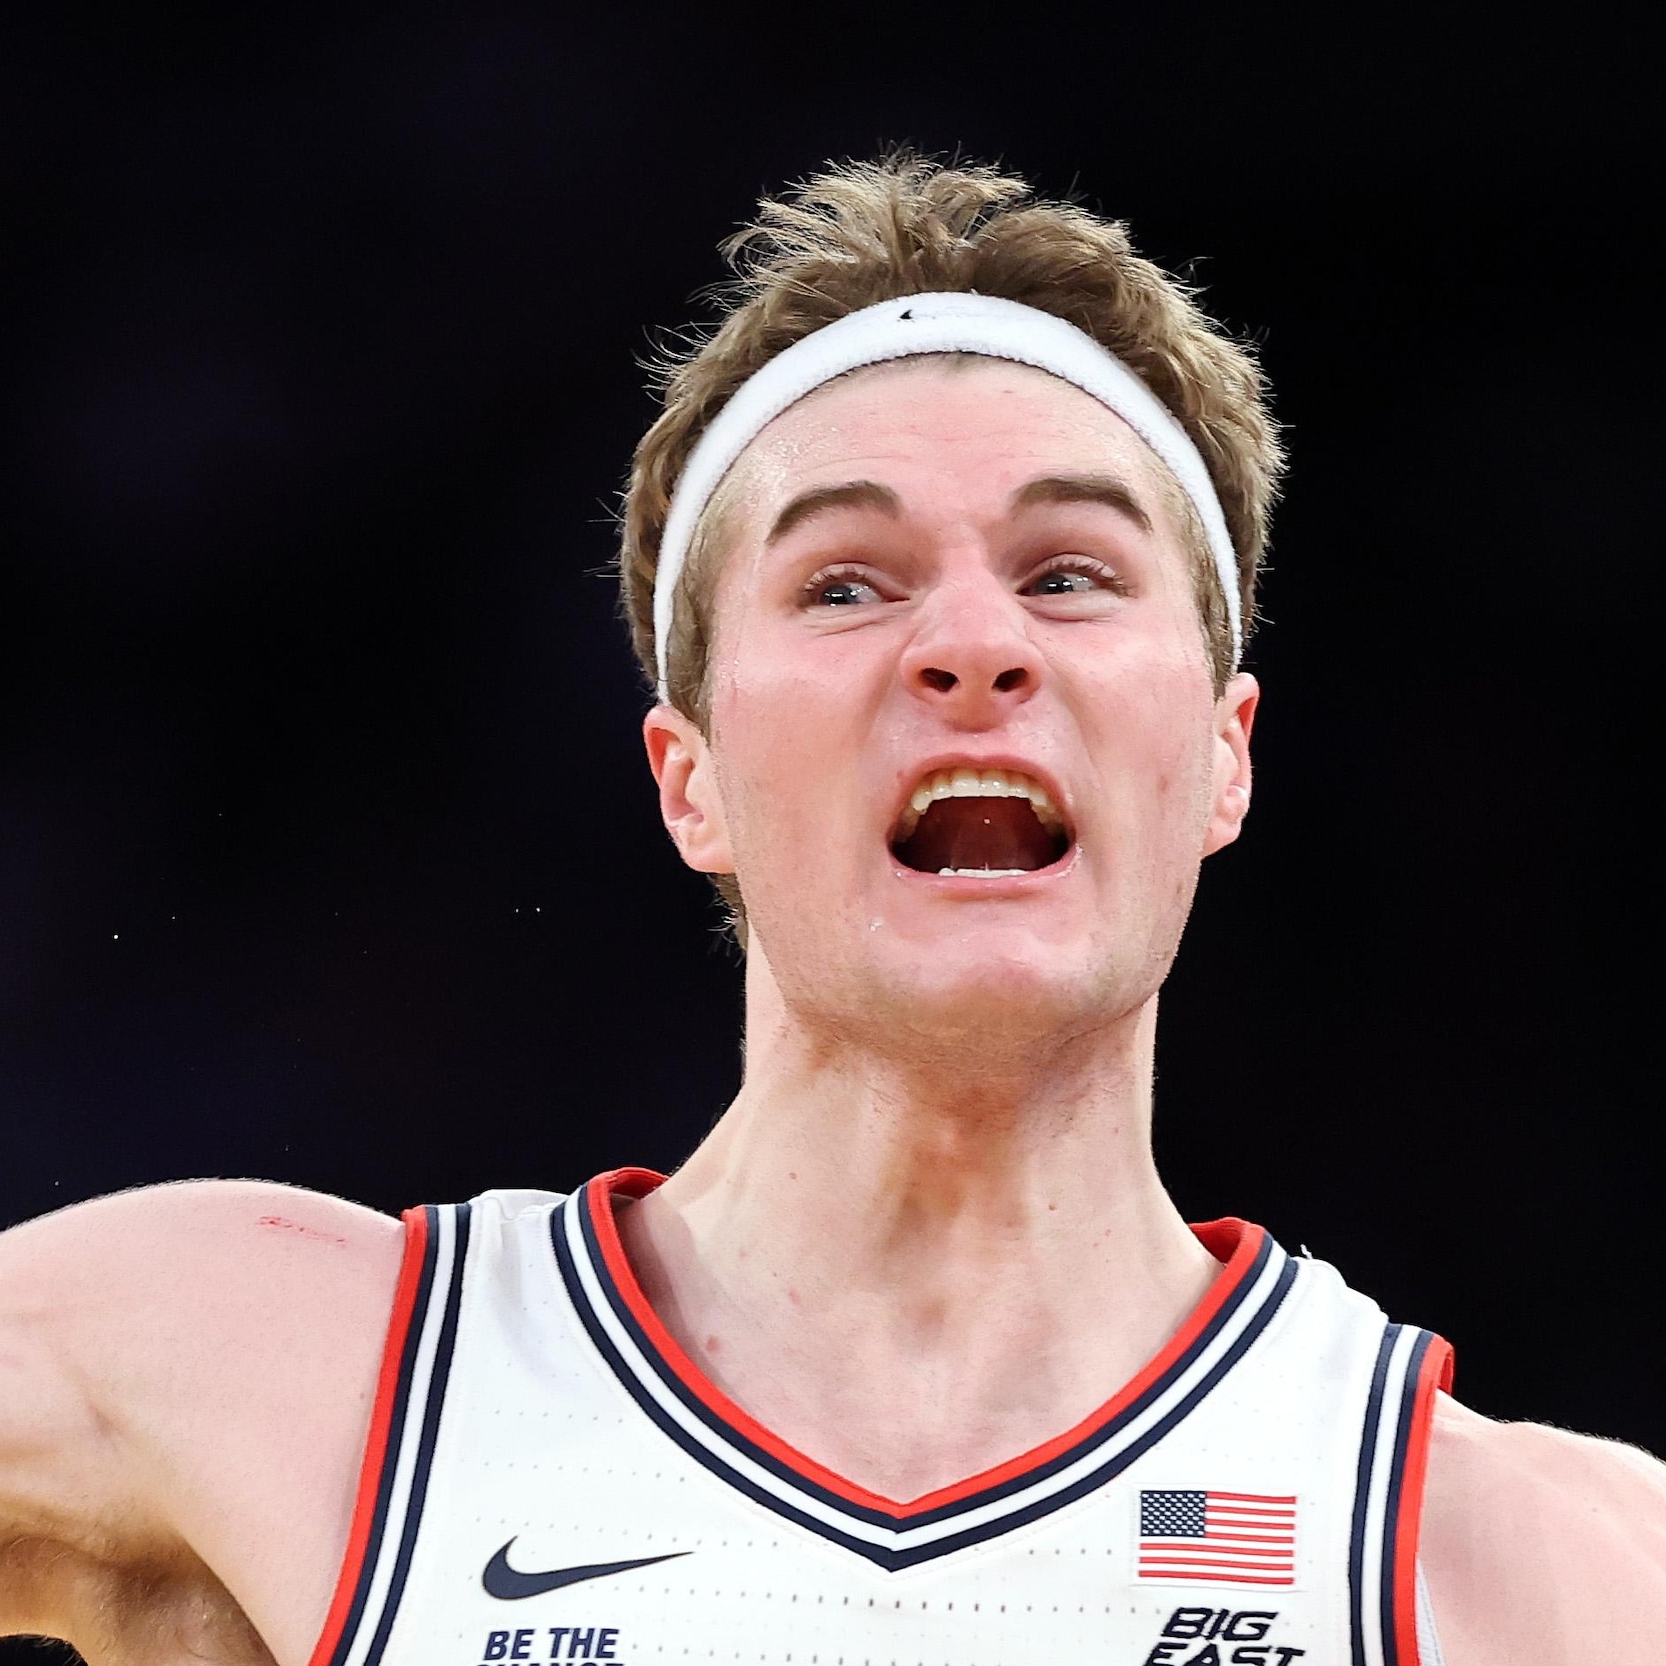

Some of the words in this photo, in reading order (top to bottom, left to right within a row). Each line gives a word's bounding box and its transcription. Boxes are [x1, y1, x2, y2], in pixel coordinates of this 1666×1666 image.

[1161, 1607, 1279, 1641] BIG
[483, 1629, 534, 1660] BE
[548, 1627, 619, 1659] THE
